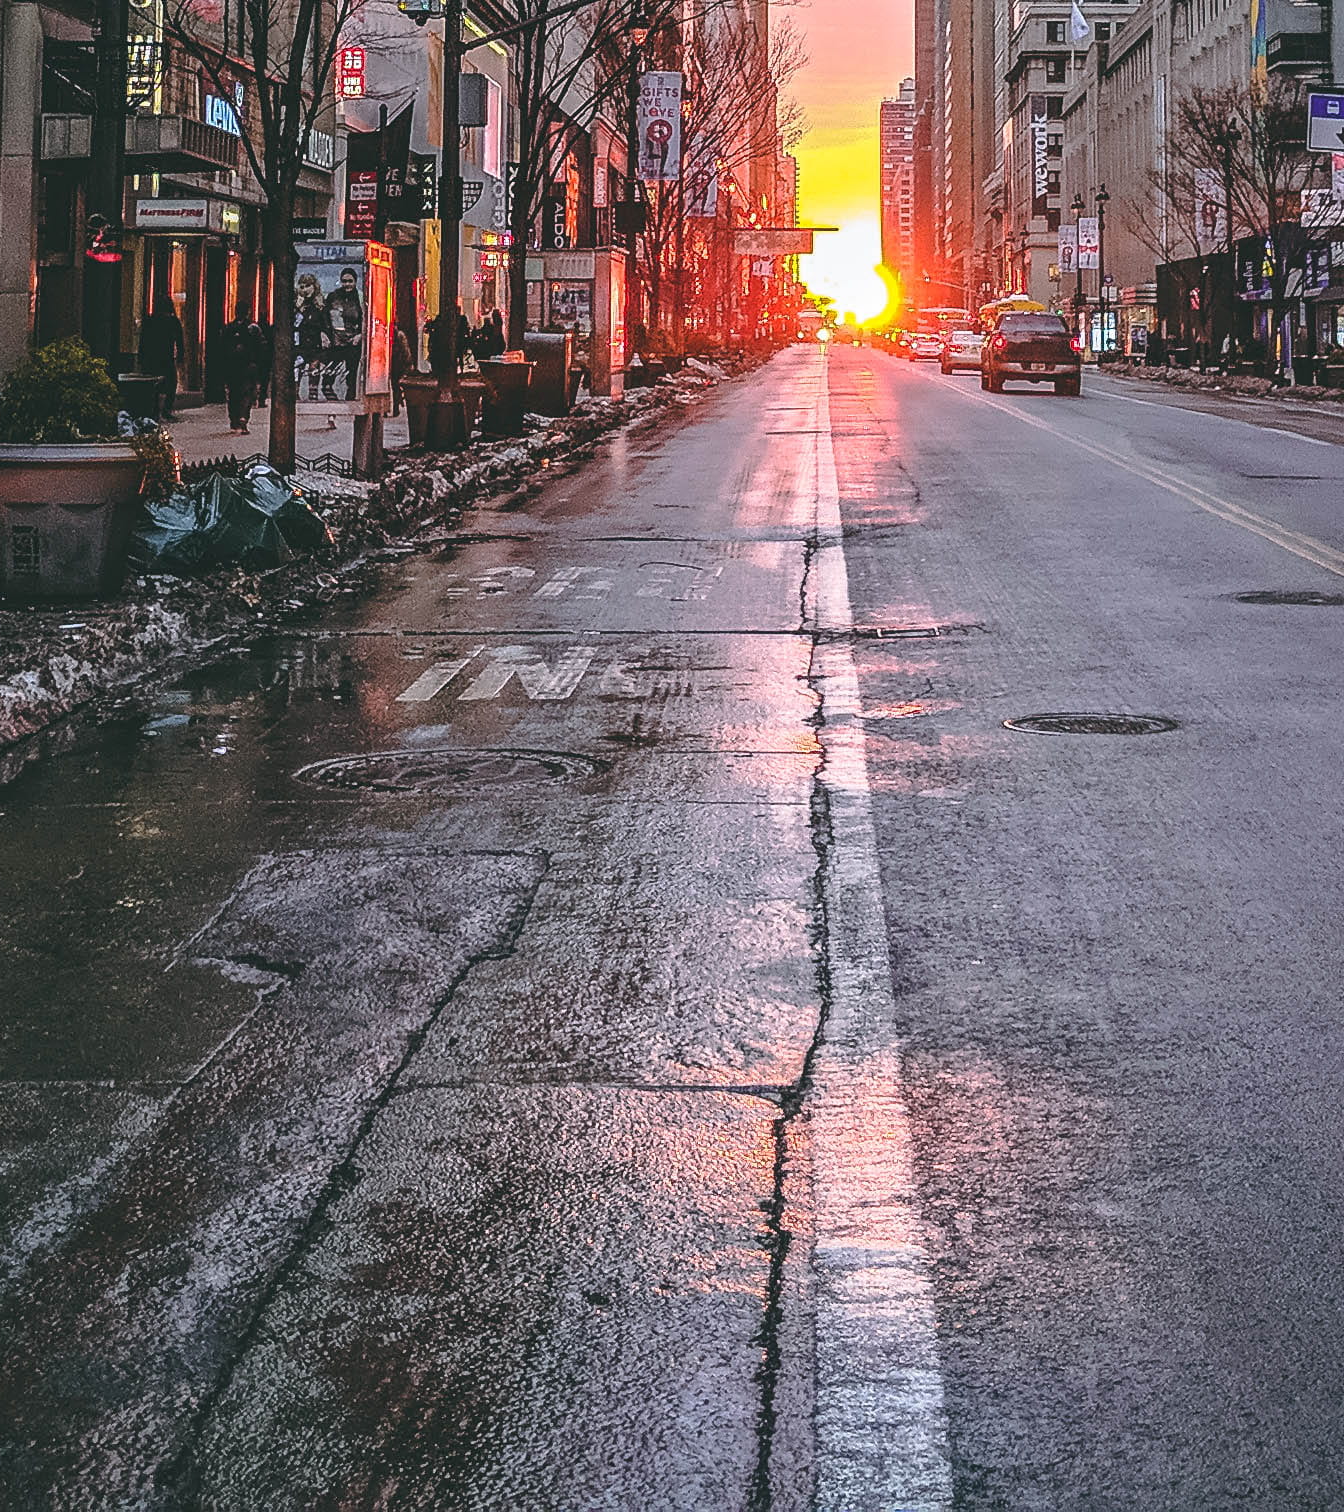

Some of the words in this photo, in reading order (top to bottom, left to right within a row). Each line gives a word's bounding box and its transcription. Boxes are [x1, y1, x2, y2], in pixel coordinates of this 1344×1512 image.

[642, 87, 679, 98] GIFTS
[642, 97, 662, 107] WE
[642, 107, 675, 118] LOVE
[1031, 113, 1048, 199] wework
[554, 202, 565, 249] ALDO
[315, 247, 347, 257] TITAN
